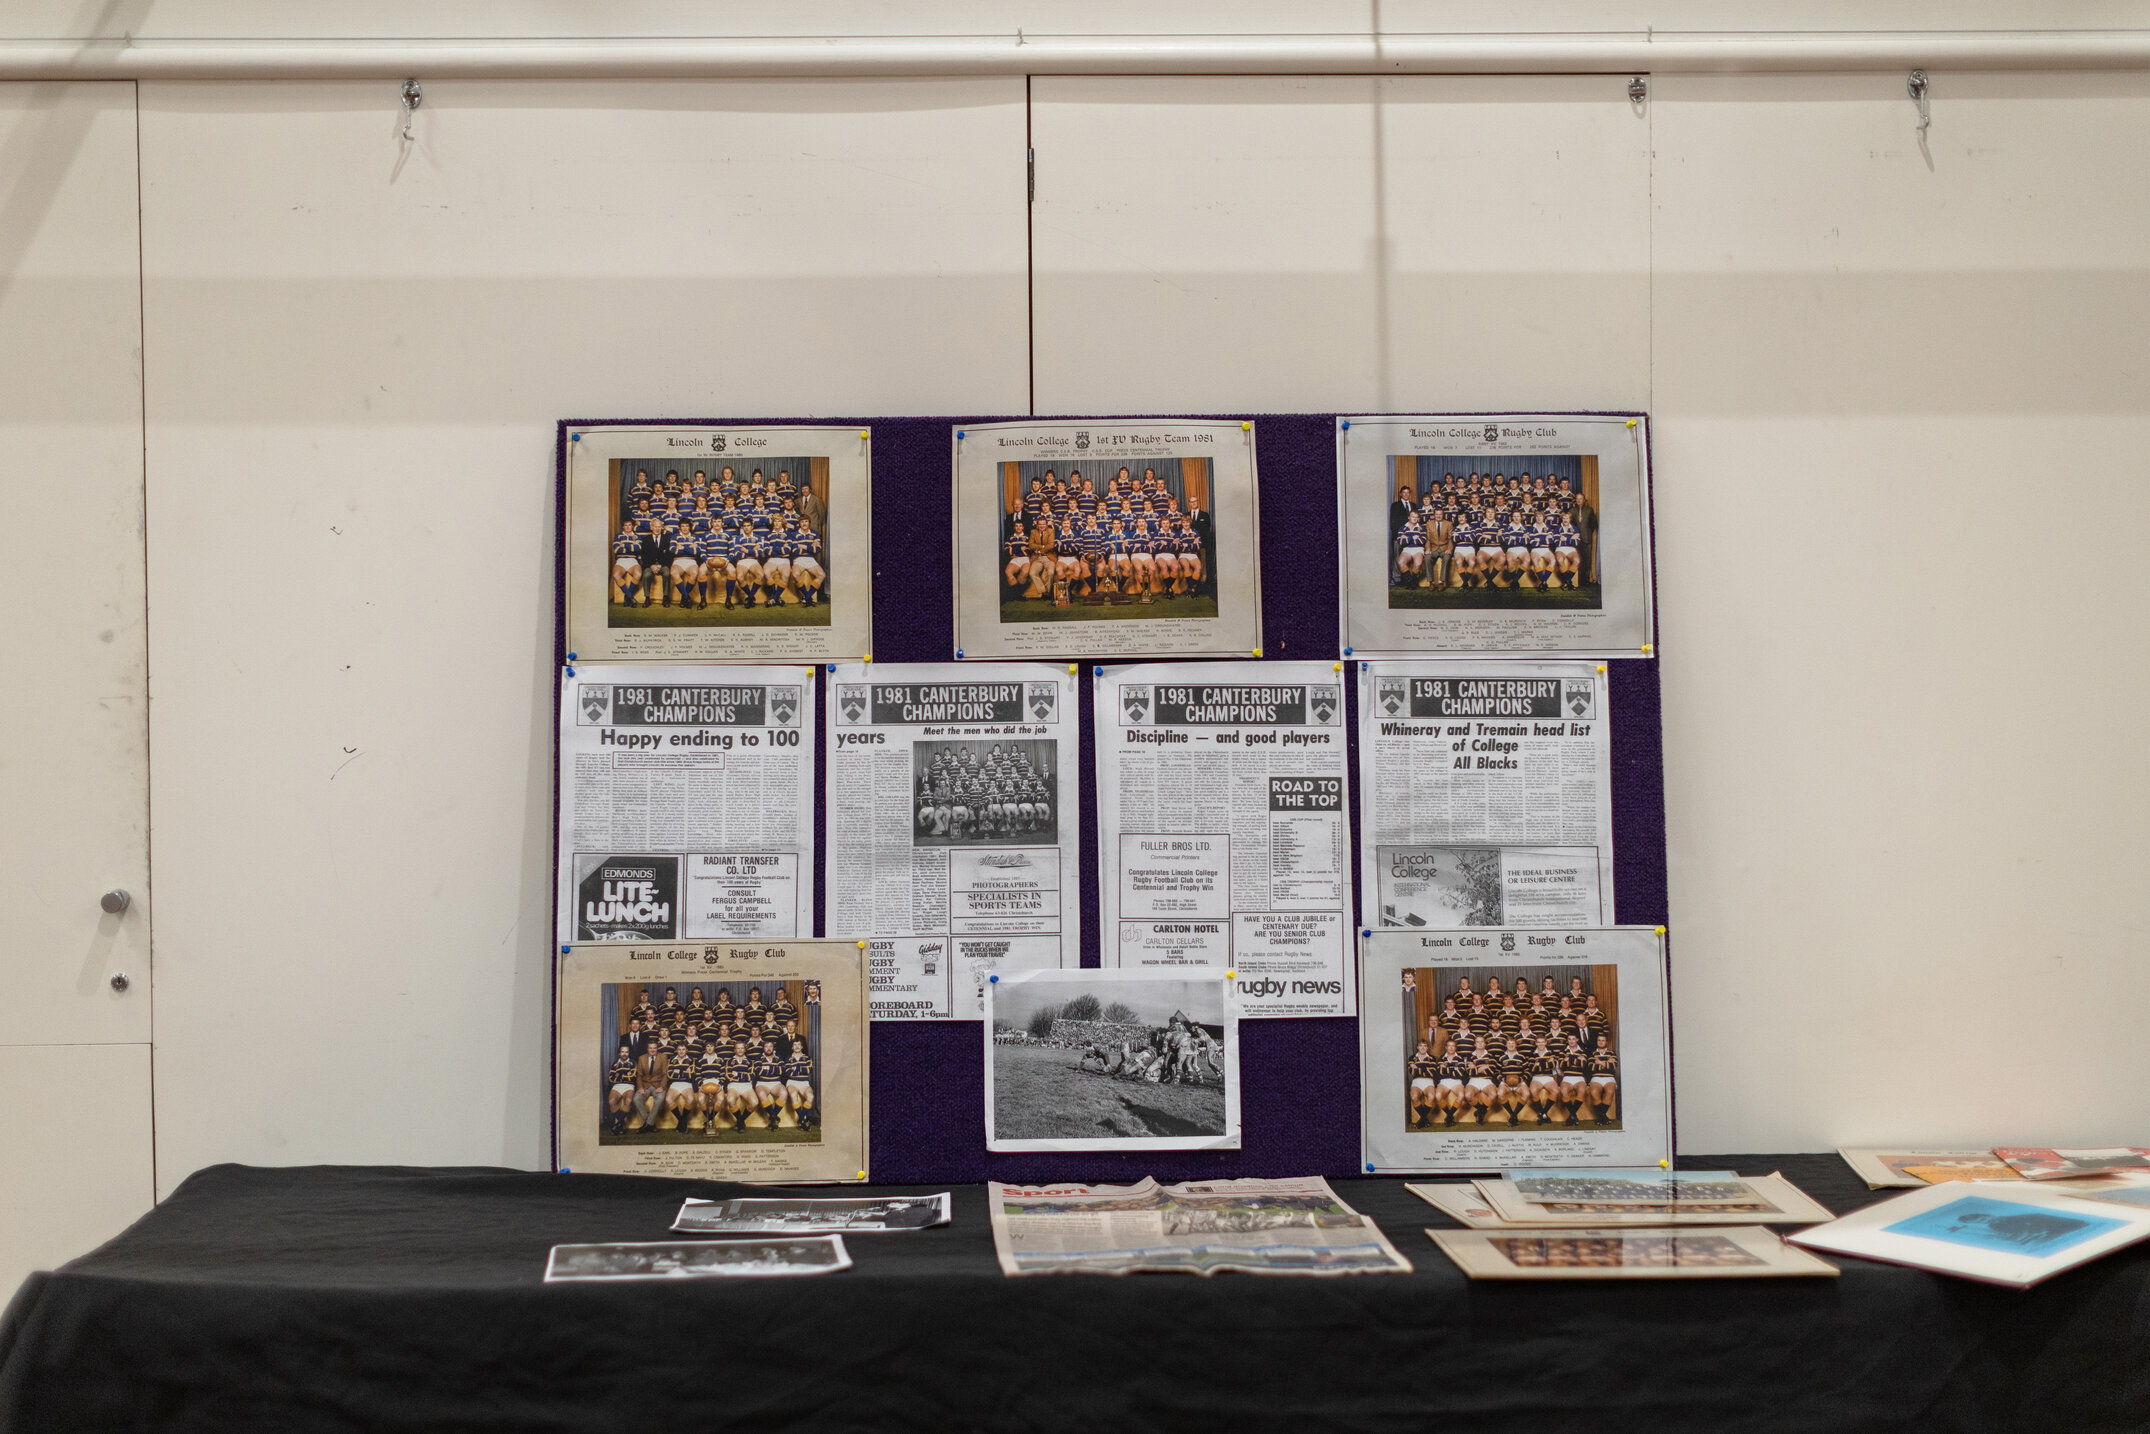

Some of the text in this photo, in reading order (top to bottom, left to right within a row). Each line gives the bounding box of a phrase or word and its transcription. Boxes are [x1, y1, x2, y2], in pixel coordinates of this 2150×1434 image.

[997, 438, 1033, 446] Lincoln
[1037, 436, 1069, 446] College
[1097, 436, 1108, 444] 1st
[1130, 435, 1160, 446] Rugby
[1164, 434, 1190, 443] Team
[1194, 434, 1214, 442] 1981
[1409, 428, 1557, 439] Lincoln College Rugby Club
[667, 438, 766, 447] Lincoln College
[876, 686, 1018, 704] 1981 CANTERBURY
[1415, 681, 1556, 698] 1981 CANTERBURY
[618, 688, 762, 705] 1981 CANTERBURY
[1159, 688, 1301, 705] 1981 CANTERBURY
[902, 703, 994, 721] CHAMPIONS
[1441, 698, 1532, 715] CHAMPIONS
[644, 706, 736, 722] CHAMPIONS
[1185, 706, 1277, 722] CHAMPIONS
[1034, 726, 1047, 735] job
[1381, 723, 1590, 738] Whineray and Tremain head list
[600, 728, 799, 750] Happy ending to 100
[836, 732, 885, 748] years
[1127, 730, 1330, 746] Discipline and good players
[1452, 739, 1519, 754] of College
[1453, 757, 1518, 769] All Blacks
[1272, 781, 1339, 792] ROAD TO
[1276, 795, 1338, 806] THE TOP
[1141, 842, 1212, 850] FULLER BROS LTD.
[704, 856, 779, 865] RADIANT TRANSFER
[1393, 852, 1434, 865] Lincoln
[604, 870, 653, 878] EDMONDS
[726, 866, 756, 874] CO. LTD
[1392, 866, 1437, 881] College
[587, 901, 669, 922] LUNCH
[1421, 936, 1585, 947] Lincoln College Rugby Club
[630, 949, 785, 961] Lincoln College Rugby Club
[919, 943, 943, 954] Gidday
[1238, 977, 1341, 997] rugby news
[870, 1010, 918, 1018] TURDAY,
[1002, 1188, 1089, 1197] Sport
